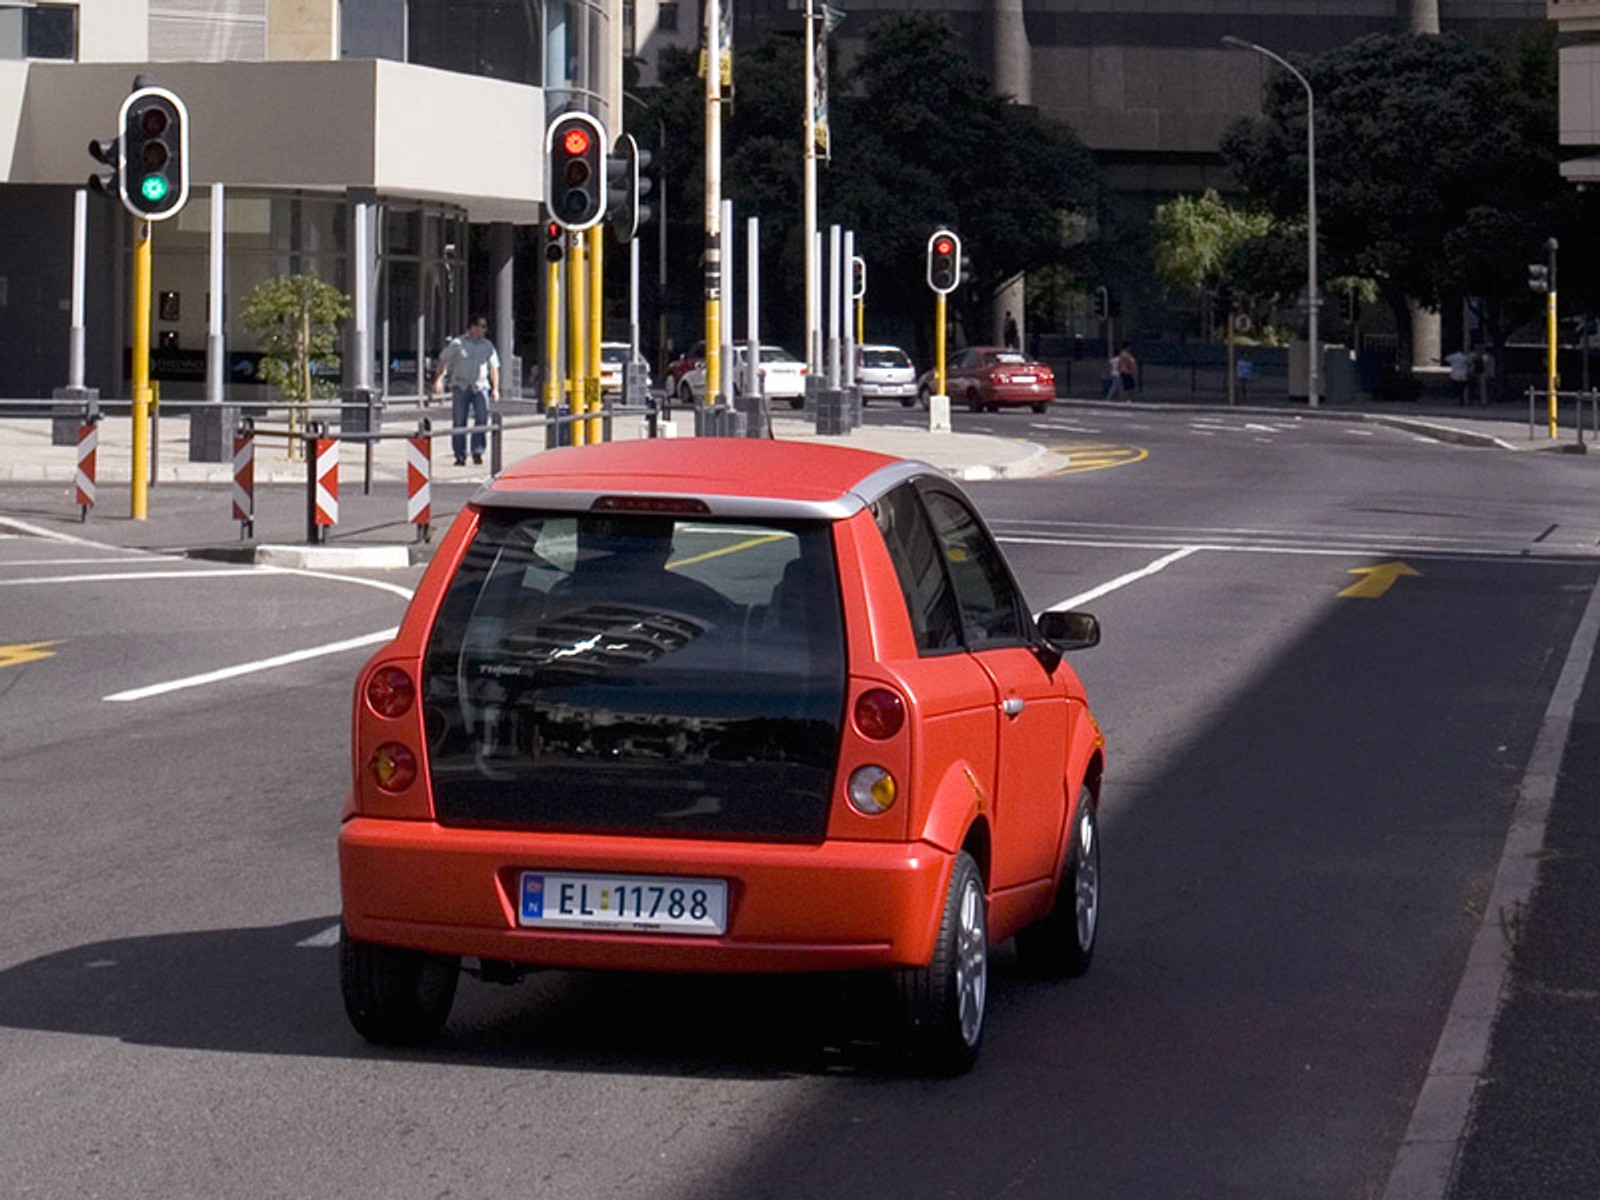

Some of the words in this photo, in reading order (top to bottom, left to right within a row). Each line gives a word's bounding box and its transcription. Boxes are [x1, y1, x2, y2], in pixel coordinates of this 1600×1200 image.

[528, 902, 538, 912] N
[559, 883, 593, 915] EL
[614, 886, 707, 920] 11788
